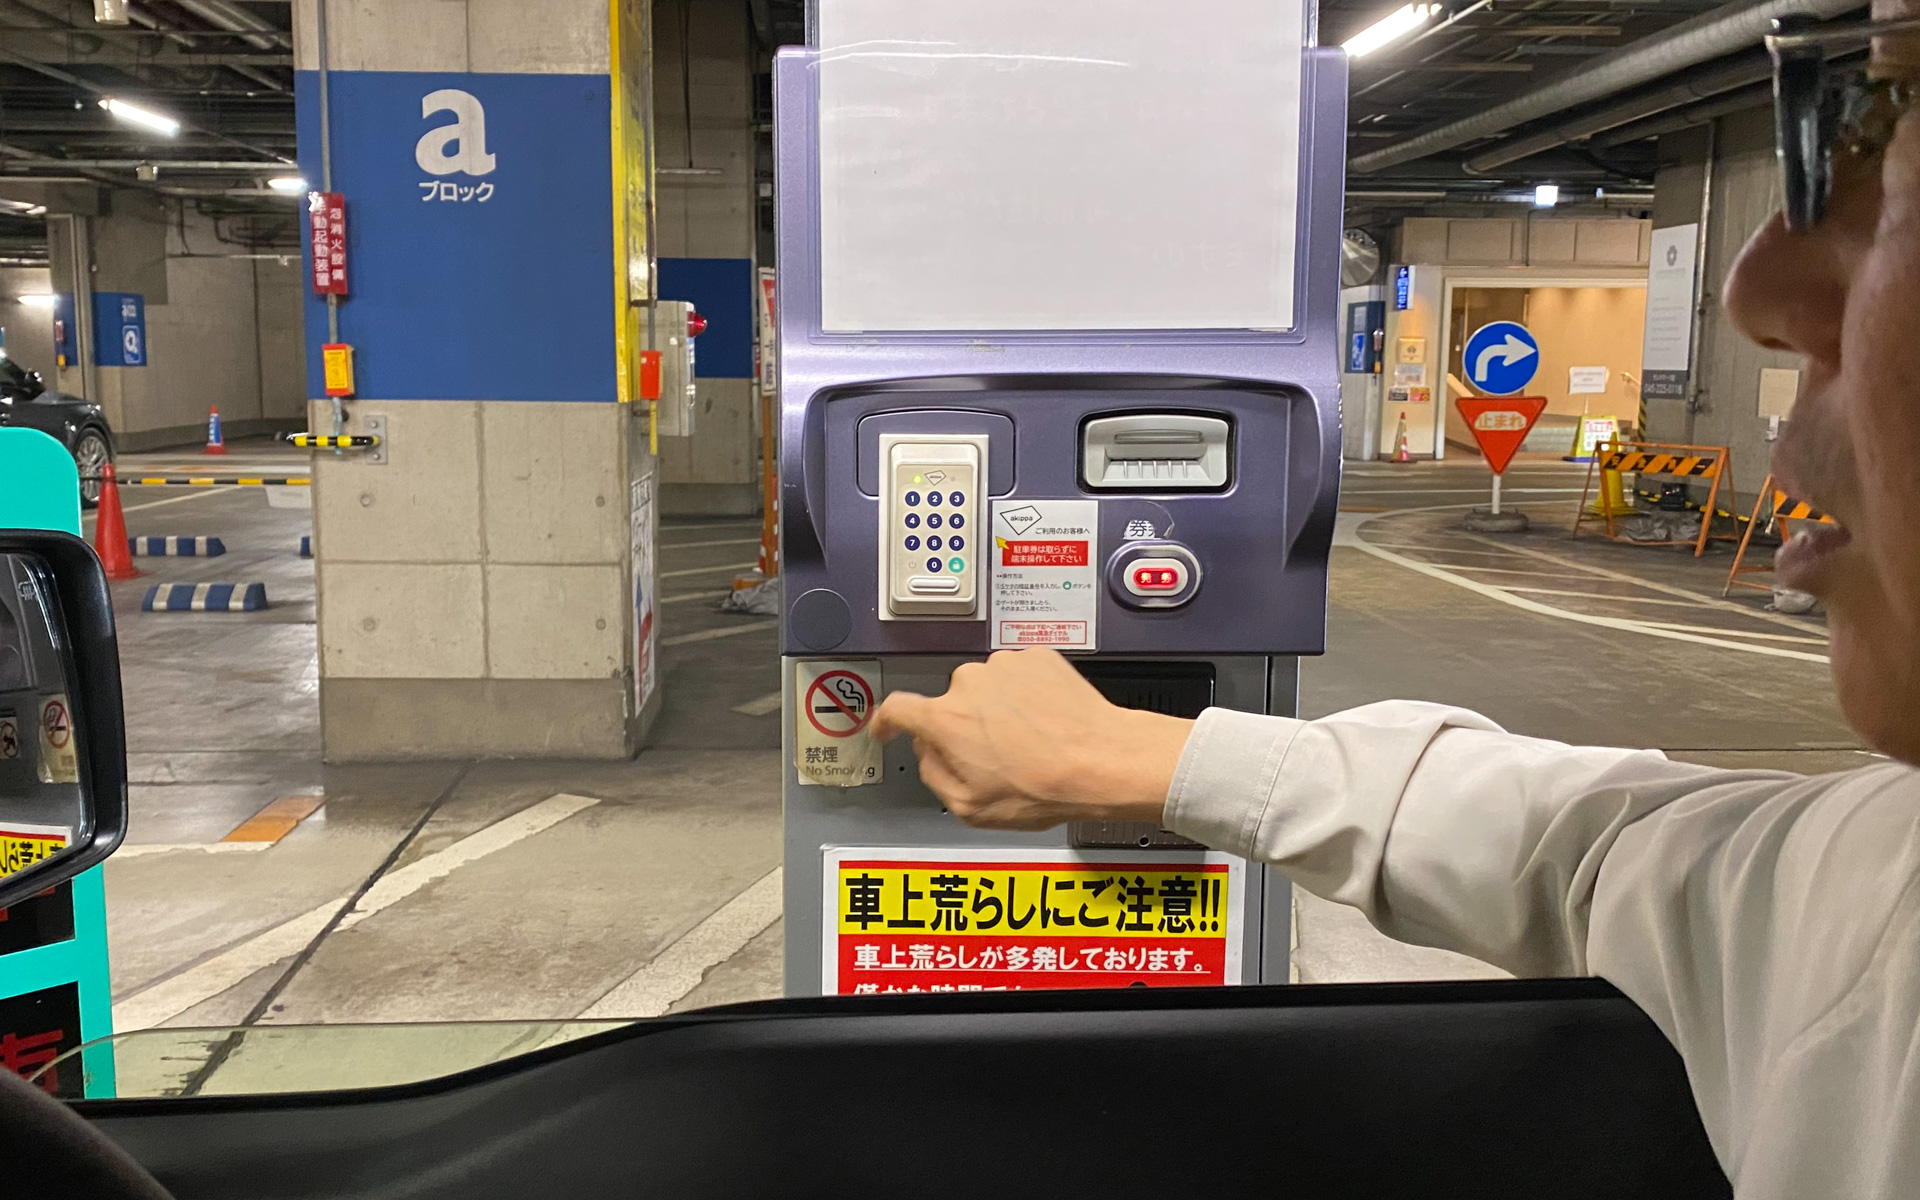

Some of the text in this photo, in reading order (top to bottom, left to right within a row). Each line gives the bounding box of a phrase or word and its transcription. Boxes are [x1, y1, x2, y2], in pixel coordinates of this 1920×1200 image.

[415, 89, 495, 175] a
[419, 180, 494, 202] ブロック
[1479, 413, 1525, 429] 止まれ
[931, 495, 938, 503] 2
[953, 495, 960, 503] 3
[909, 517, 960, 525] 4 5 6
[1035, 527, 1090, 535] ご利用のお客様へ
[909, 539, 960, 547] 7 8 9
[1013, 545, 1077, 554] 駐車券は取らずに
[1011, 555, 1082, 564] 端末操作して下さい
[931, 561, 938, 569] 0
[805, 746, 838, 763] 禁煙
[805, 766, 822, 775] No
[845, 873, 1220, 934] 車上荒らしにご注意!!
[854, 944, 1203, 972] 車上荒らしが多発しております。
